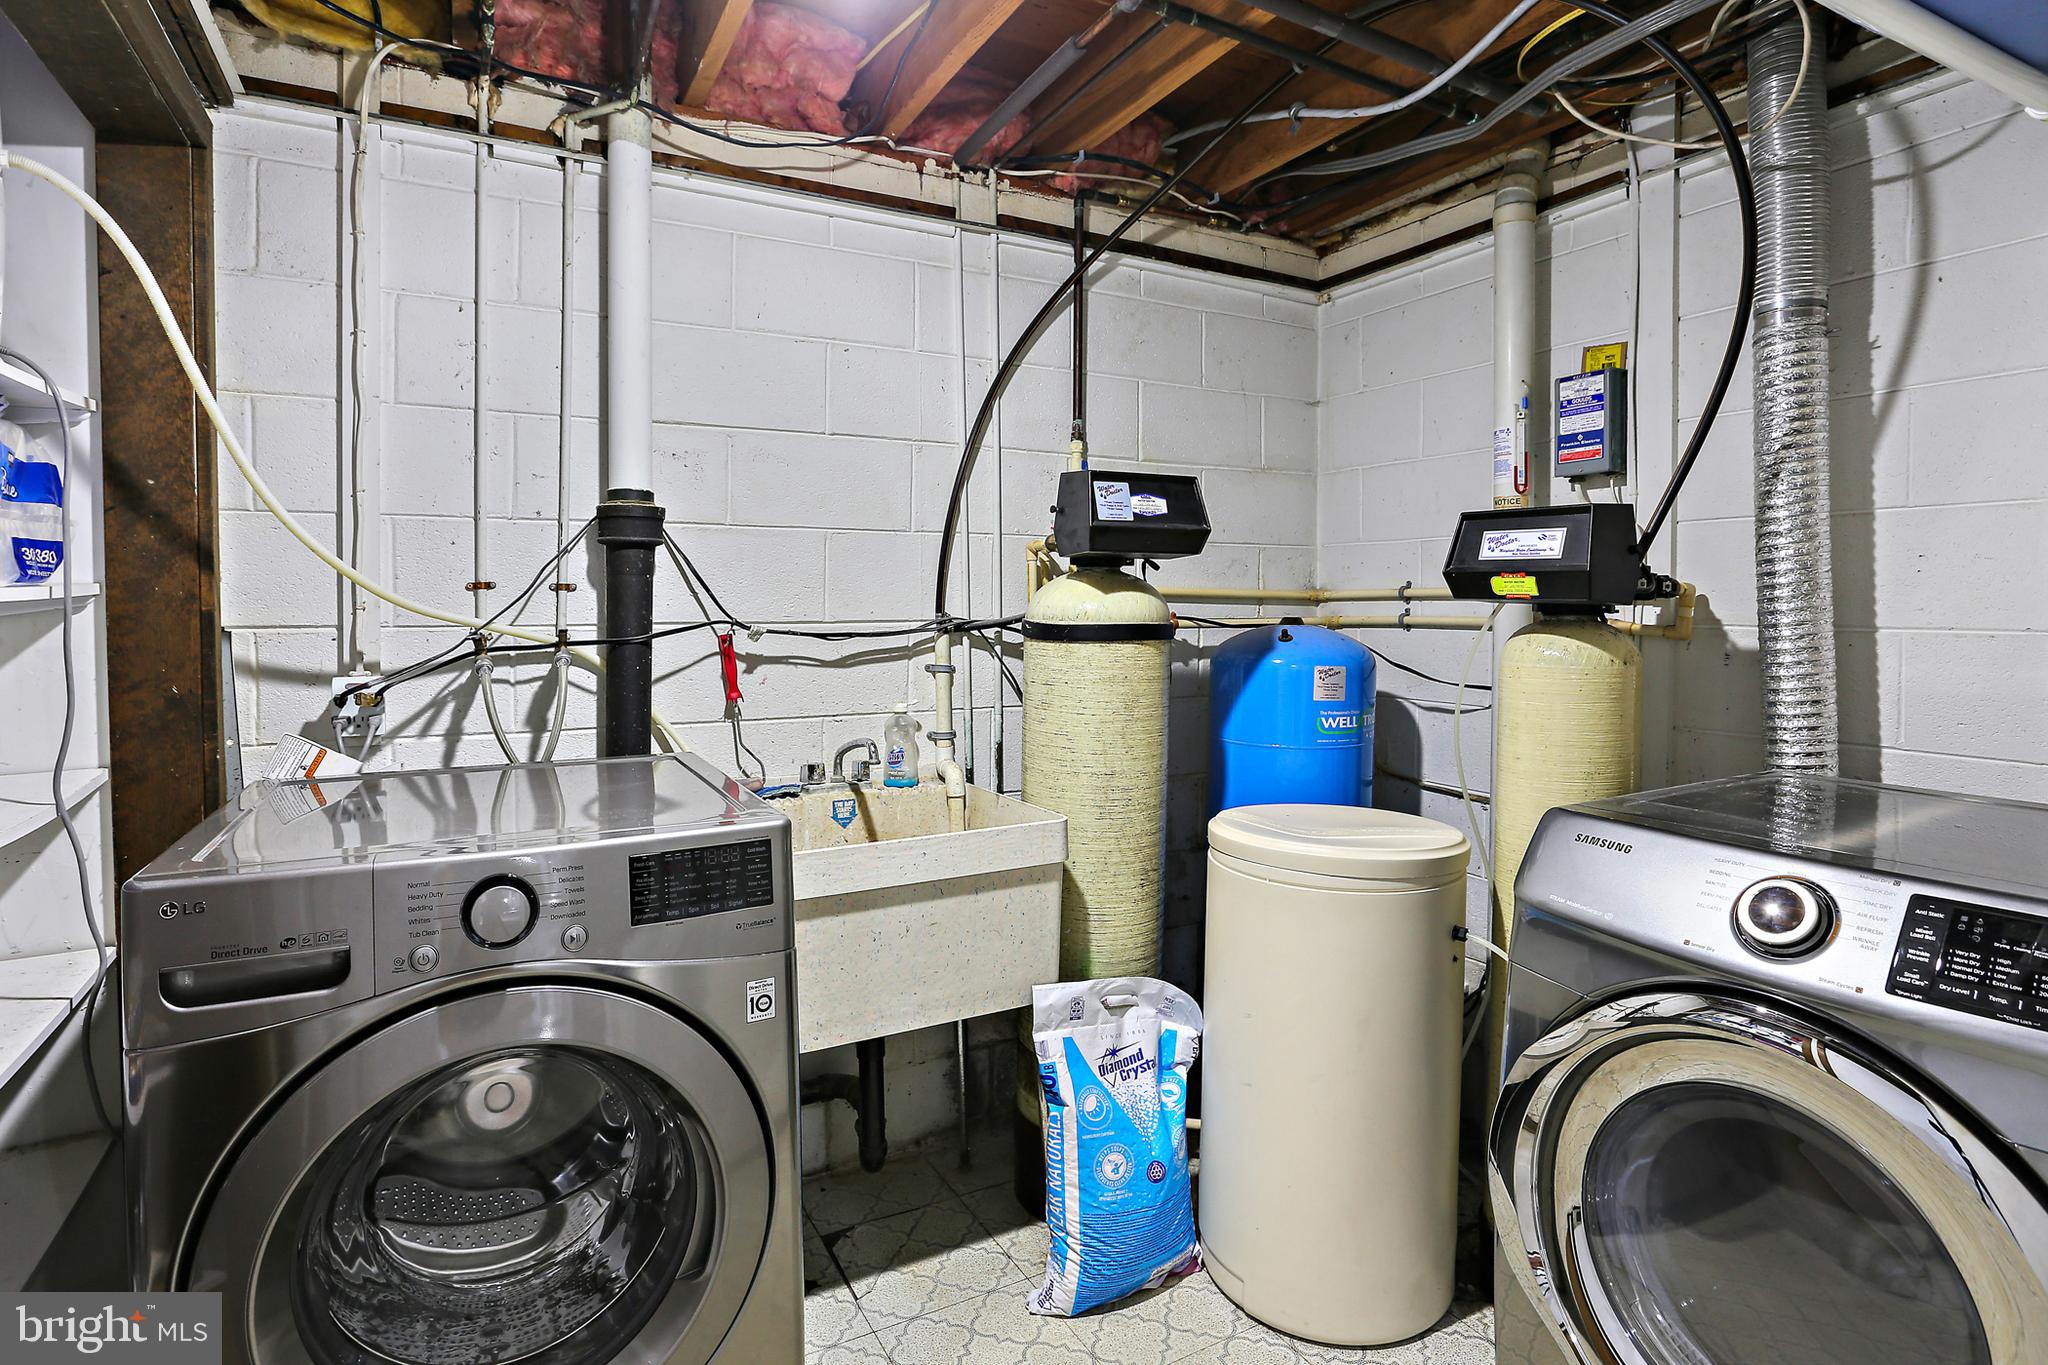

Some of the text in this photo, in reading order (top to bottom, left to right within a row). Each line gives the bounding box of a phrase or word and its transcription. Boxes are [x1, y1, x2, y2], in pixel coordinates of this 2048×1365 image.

[1487, 534, 1509, 544] Water
[1495, 537, 1518, 549] Doctor
[1321, 716, 1358, 728] WELL
[1575, 833, 1633, 854] SAMSUNG
[558, 875, 585, 883] Delicates
[408, 880, 431, 889] Normal
[564, 886, 585, 894] Towels
[408, 891, 444, 901] Heavy Duty
[183, 901, 206, 915] LG
[408, 904, 433, 913] Bedding
[550, 898, 586, 909] Speed Wash
[550, 911, 586, 920] Downloaded
[1928, 911, 1945, 919] Static
[408, 917, 431, 926] Whites
[408, 928, 440, 939] Tub Clean
[1856, 925, 1883, 936] REFRESH
[1915, 927, 1933, 936] Mixed
[1853, 936, 1880, 947] WRINKLE
[1994, 942, 2010, 950] Drying
[211, 949, 241, 960] Direct
[243, 945, 268, 956] Drive
[1861, 944, 1878, 952] AWAY
[1908, 948, 1930, 957] Wrinkle
[1907, 954, 1929, 963] Prevent
[1955, 949, 1981, 960] Very Dry
[1969, 959, 1981, 967] Dry
[1997, 958, 2012, 966] High
[1904, 971, 1920, 979] Small
[1952, 964, 1985, 976] Normal Dry
[1995, 965, 2020, 975] Medium
[1819, 976, 1836, 986] Steam
[1897, 975, 1911, 983] Load
[1950, 971, 1979, 982] Damp Dry
[1939, 983, 1970, 995] Dry Level
[1992, 980, 2008, 988] Extra
[1988, 994, 2008, 1004] Temp.
[749, 994, 773, 1016] 10
[1098, 1048, 1144, 1077] Diamond
